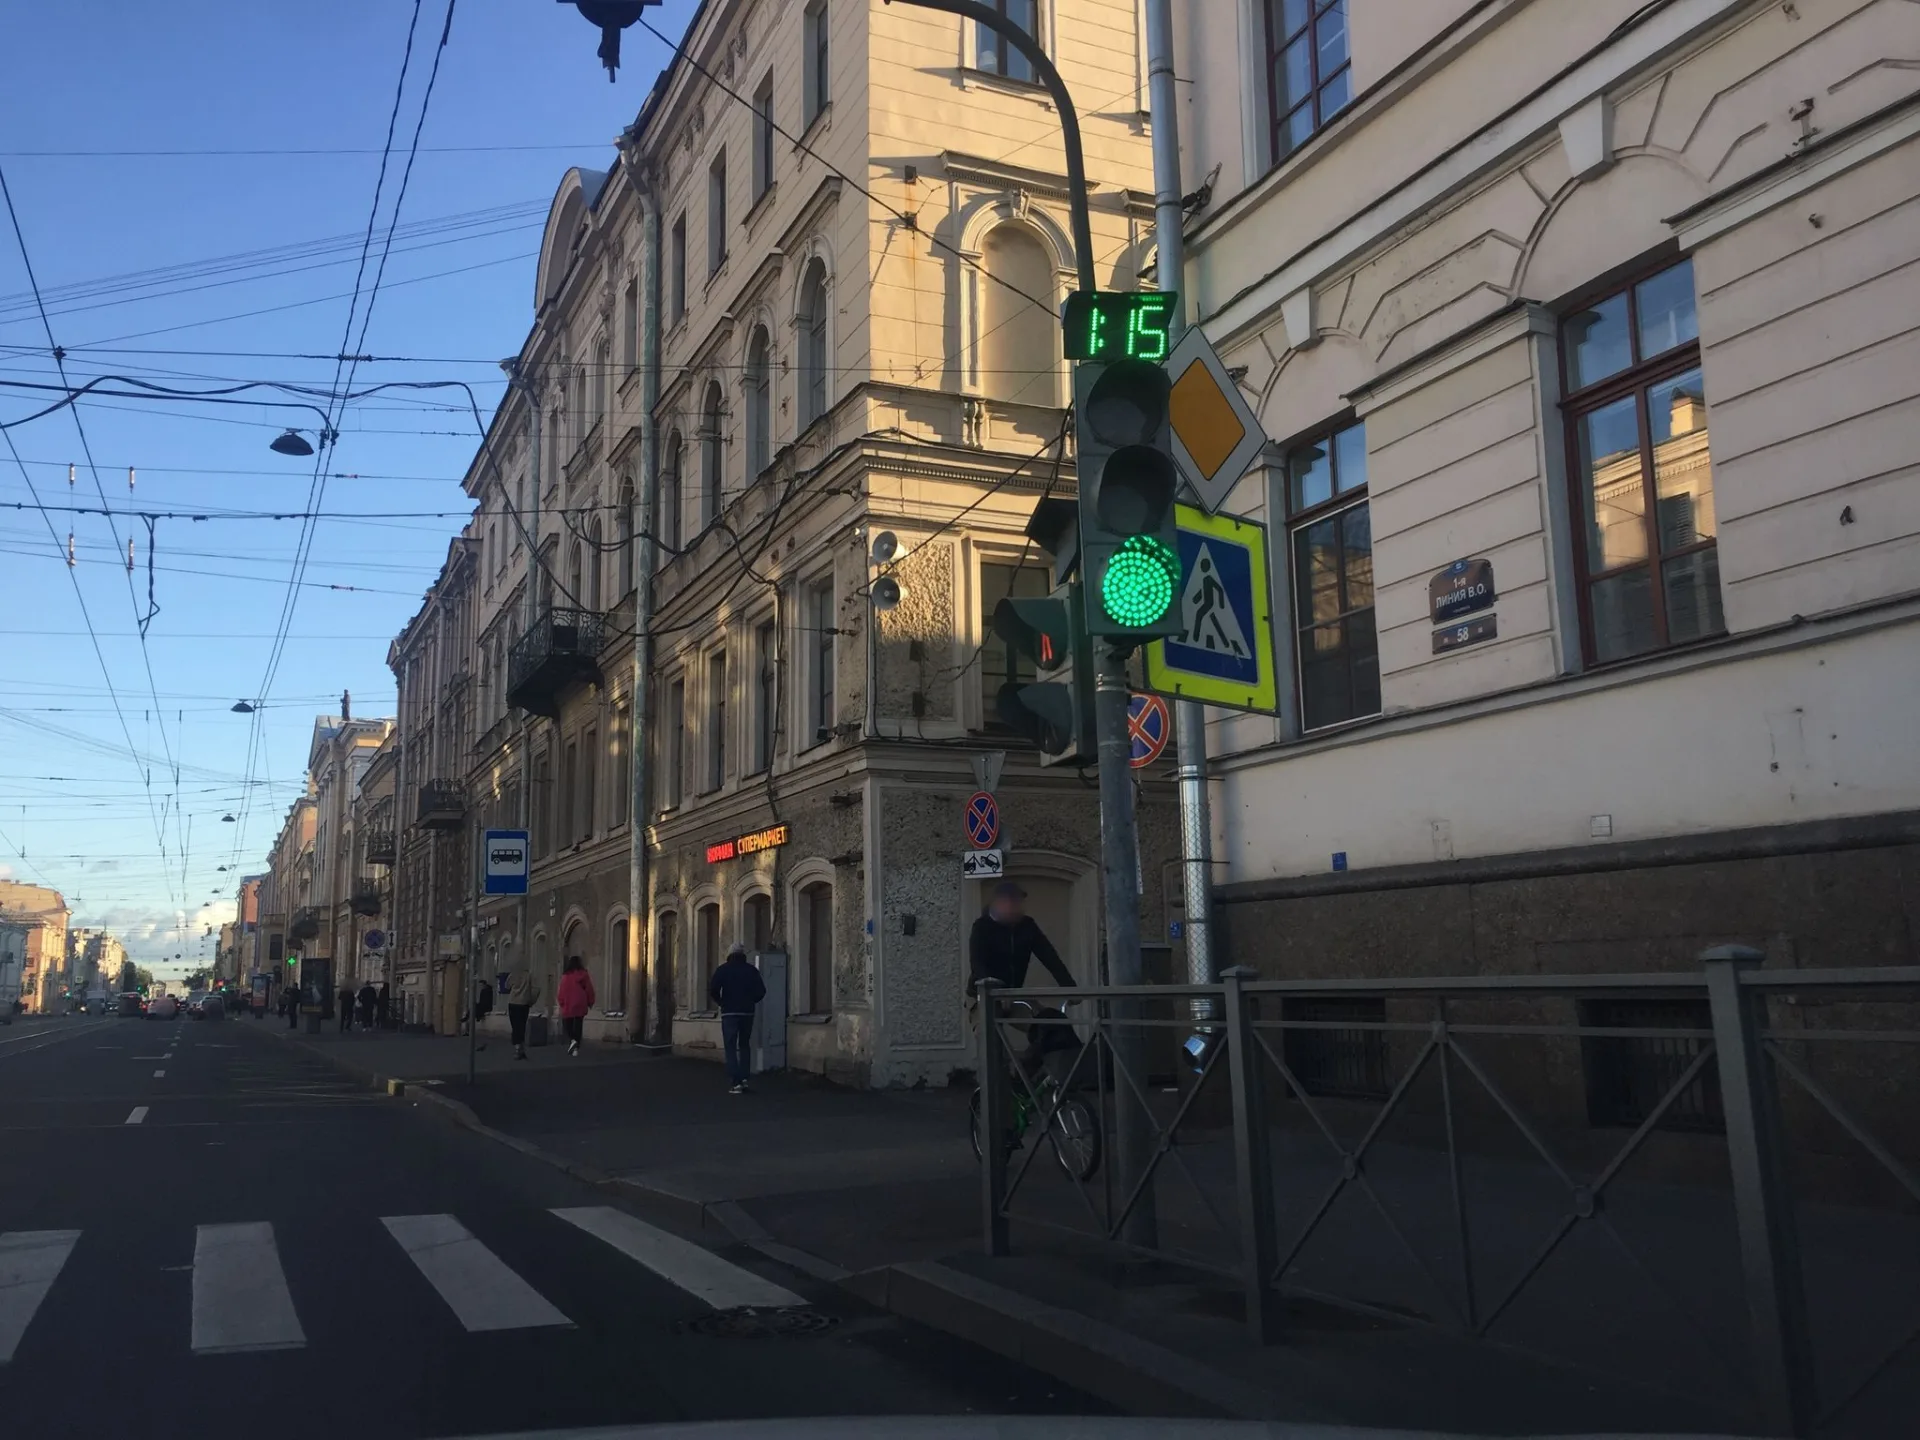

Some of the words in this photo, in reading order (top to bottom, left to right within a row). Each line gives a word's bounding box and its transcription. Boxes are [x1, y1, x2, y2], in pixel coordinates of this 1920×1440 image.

[1435, 590, 1467, 608] ЛИНИЯ
[1468, 583, 1487, 597] В.О.
[1456, 626, 1469, 642] 58
[737, 826, 787, 855] СУПЕРМАРКЕТ
